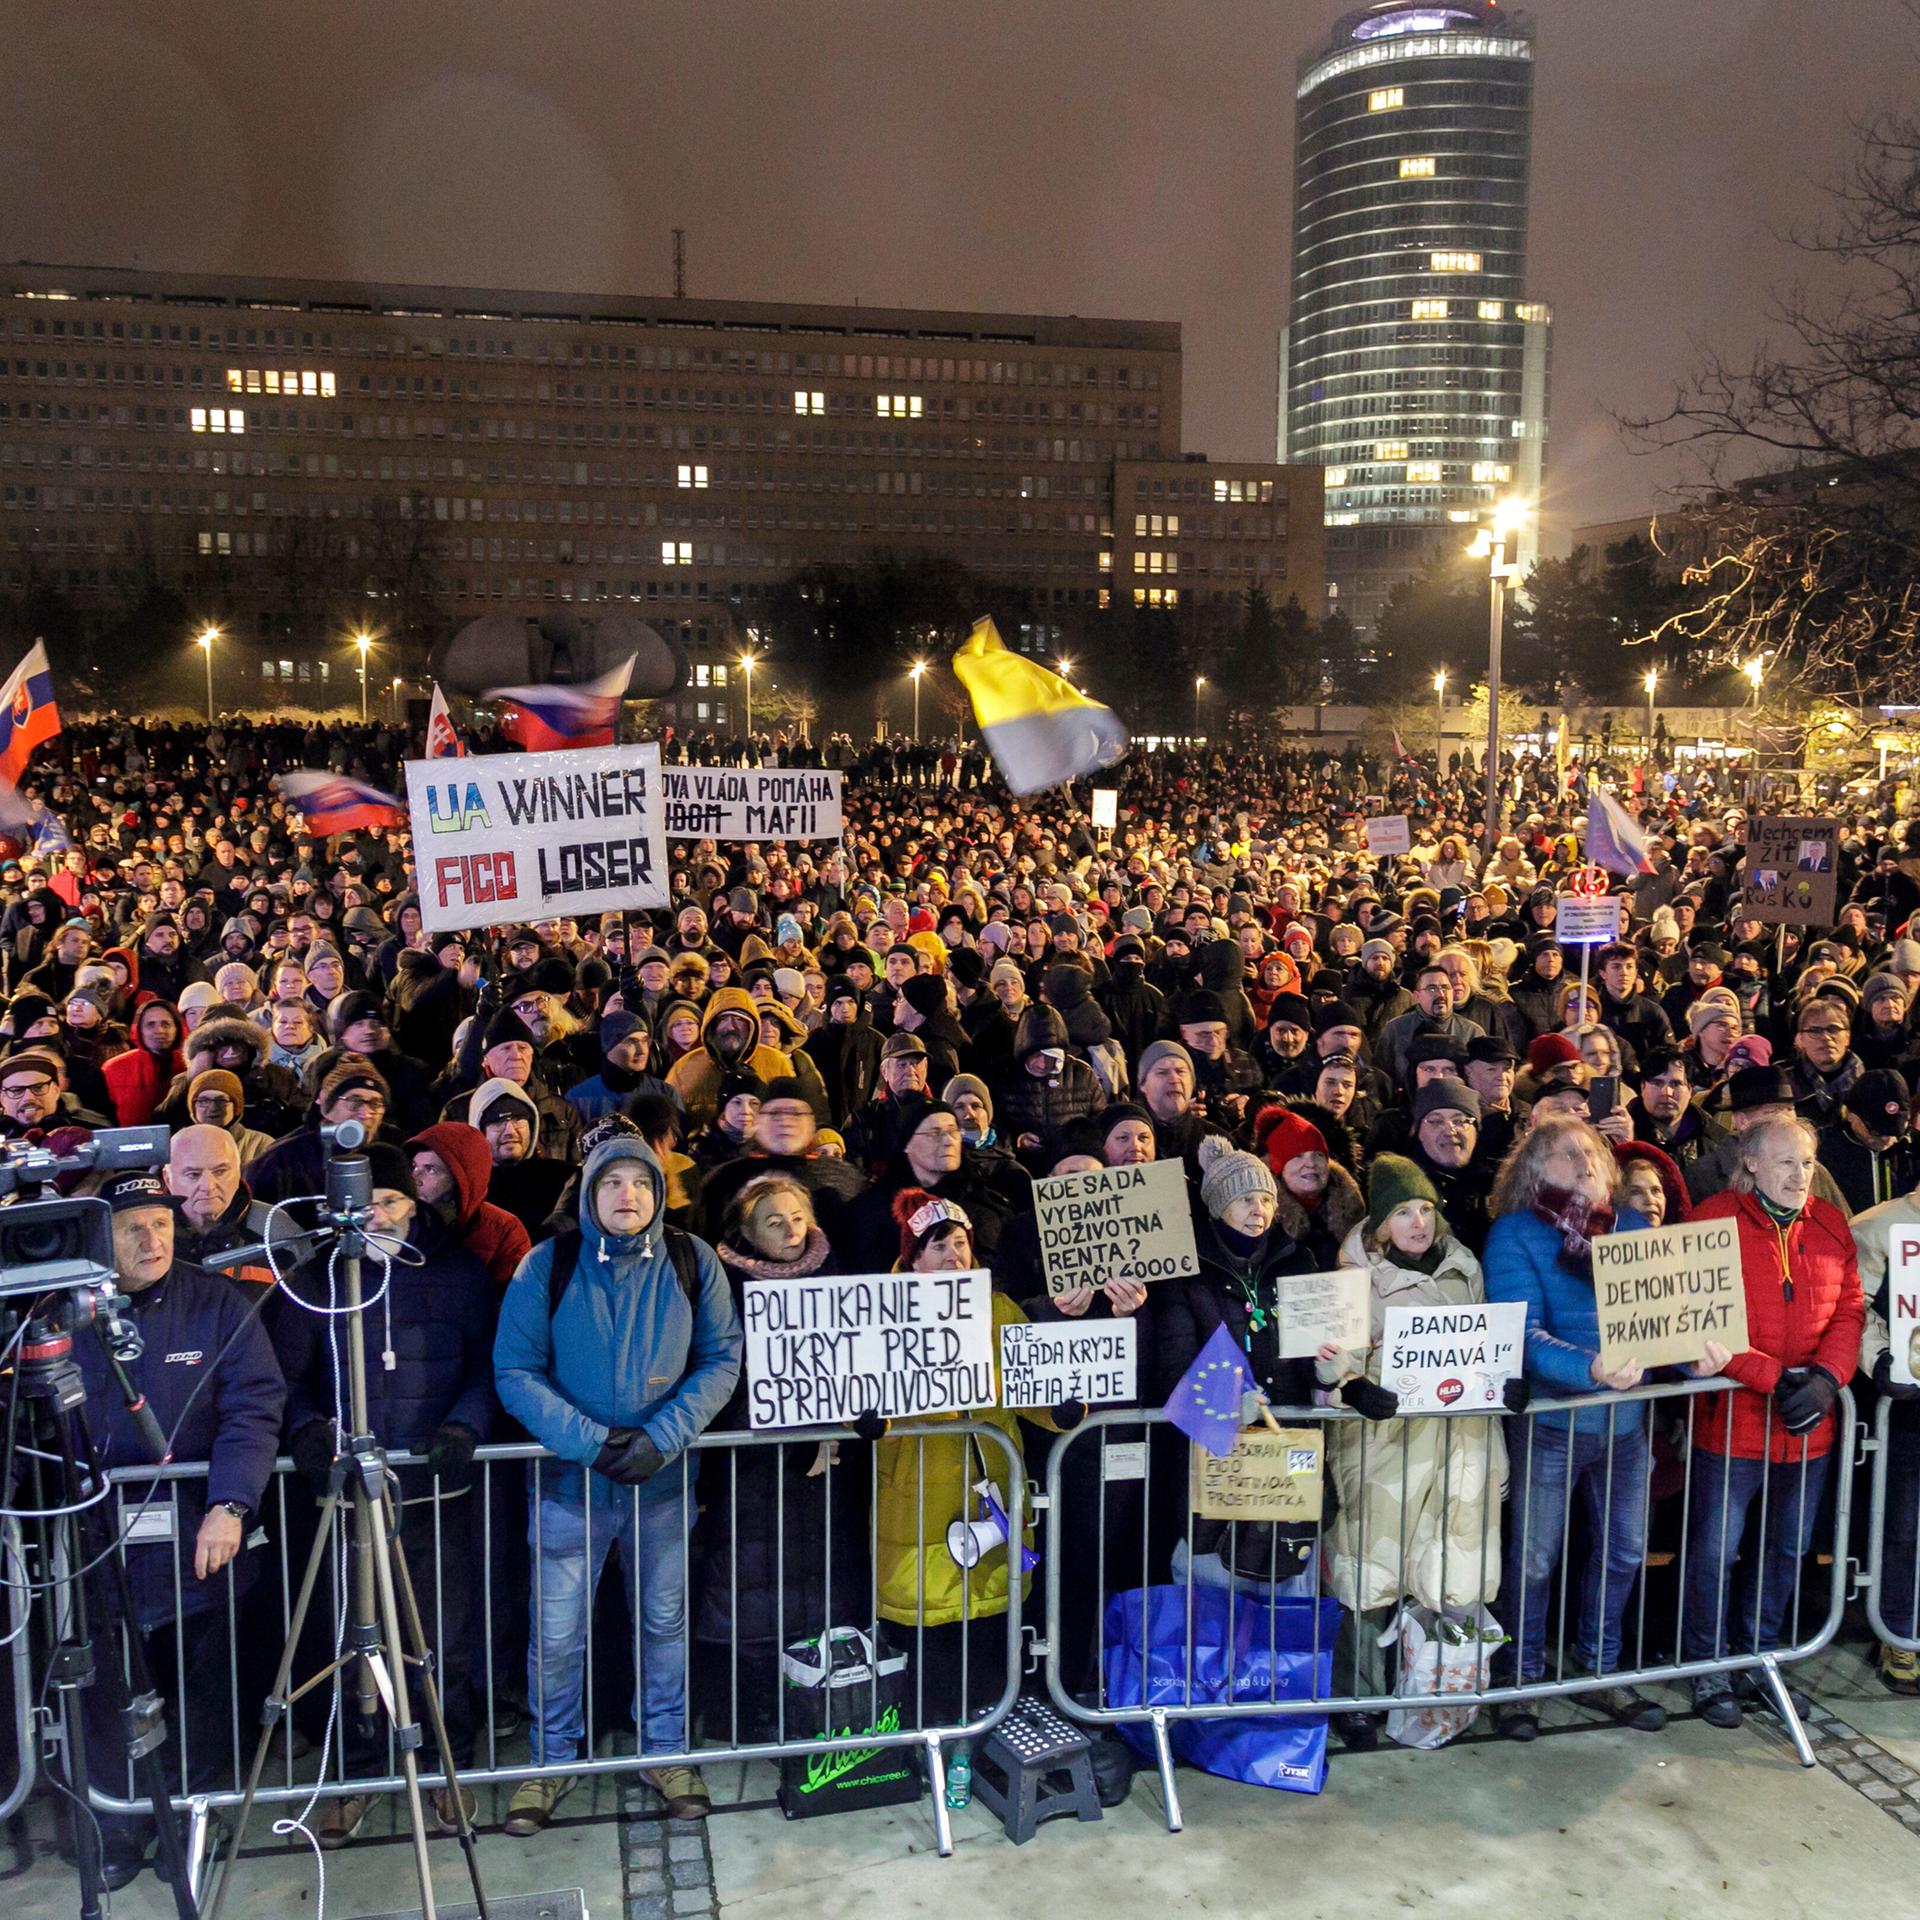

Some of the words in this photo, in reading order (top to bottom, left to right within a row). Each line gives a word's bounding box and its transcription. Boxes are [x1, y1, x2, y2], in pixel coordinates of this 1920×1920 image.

[426, 782, 493, 834] UA
[498, 768, 647, 826] WINNER
[694, 772, 750, 802] VLÁDA
[758, 773, 834, 803] POMÁHA
[746, 805, 816, 834] MAFII
[435, 851, 518, 907] FICO
[538, 838, 652, 894] LOSER
[1037, 1178, 1079, 1202] KDE
[1084, 1174, 1112, 1194] SA
[1116, 1168, 1146, 1189] DA
[1043, 1210, 1163, 1248] DOŽIVOTNÁ
[1598, 1238, 1674, 1266] PODLIAK
[1682, 1230, 1731, 1254] FICO
[1605, 1266, 1732, 1306] DEMONTUJE
[747, 1281, 871, 1333] POLITIKA
[880, 1281, 921, 1325] NIE
[933, 1277, 973, 1321] JE
[1606, 1311, 1669, 1345] PRÁVNY
[1676, 1301, 1734, 1334] ŠTÁT
[1003, 1325, 1033, 1343] KDE
[1004, 1337, 1064, 1366] VLÁDA
[1069, 1336, 1125, 1364] KRYJE
[766, 1326, 862, 1381] ÚKRYT
[880, 1326, 961, 1372] PRED
[1392, 1341, 1486, 1369] ŠPINAVÁ
[1003, 1368, 1033, 1381] TAM
[1006, 1378, 1063, 1405] MAFIA
[1068, 1369, 1124, 1400] ŽIJE
[836, 1769, 909, 1788] www.chicoree.c
